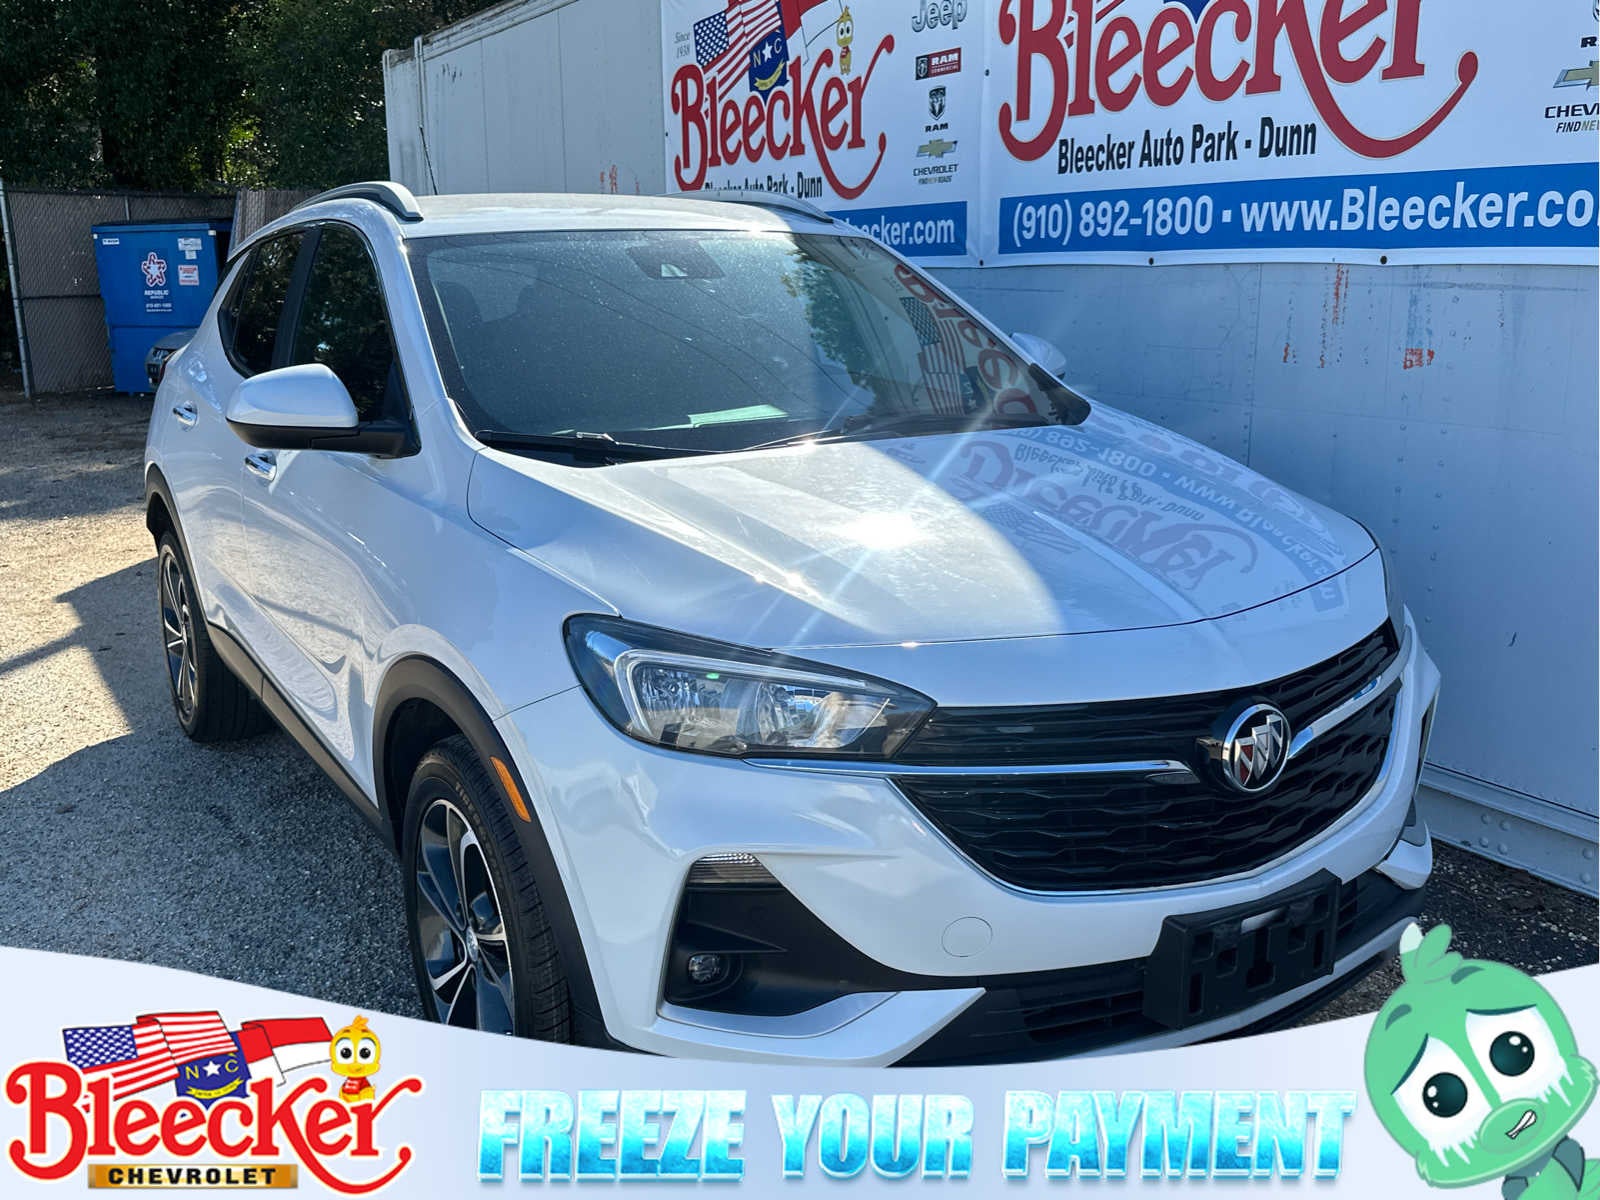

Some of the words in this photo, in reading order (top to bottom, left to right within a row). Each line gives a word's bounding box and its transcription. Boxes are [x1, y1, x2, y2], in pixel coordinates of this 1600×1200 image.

[911, 0, 968, 33] Jeep
[931, 53, 959, 66] RAM
[671, 34, 895, 200] Bleecker
[924, 122, 949, 133] RAM
[1058, 132, 1136, 174] Bleecker
[1138, 127, 1184, 168] Auto
[1190, 120, 1239, 163] Park
[1258, 116, 1318, 158] Dunn
[797, 171, 822, 199] Dunn
[912, 163, 959, 177] CHEVROLET
[1012, 198, 1073, 247] (910)
[1078, 194, 1214, 239] 892-1800
[1240, 181, 1599, 233] www.Bleecker.co
